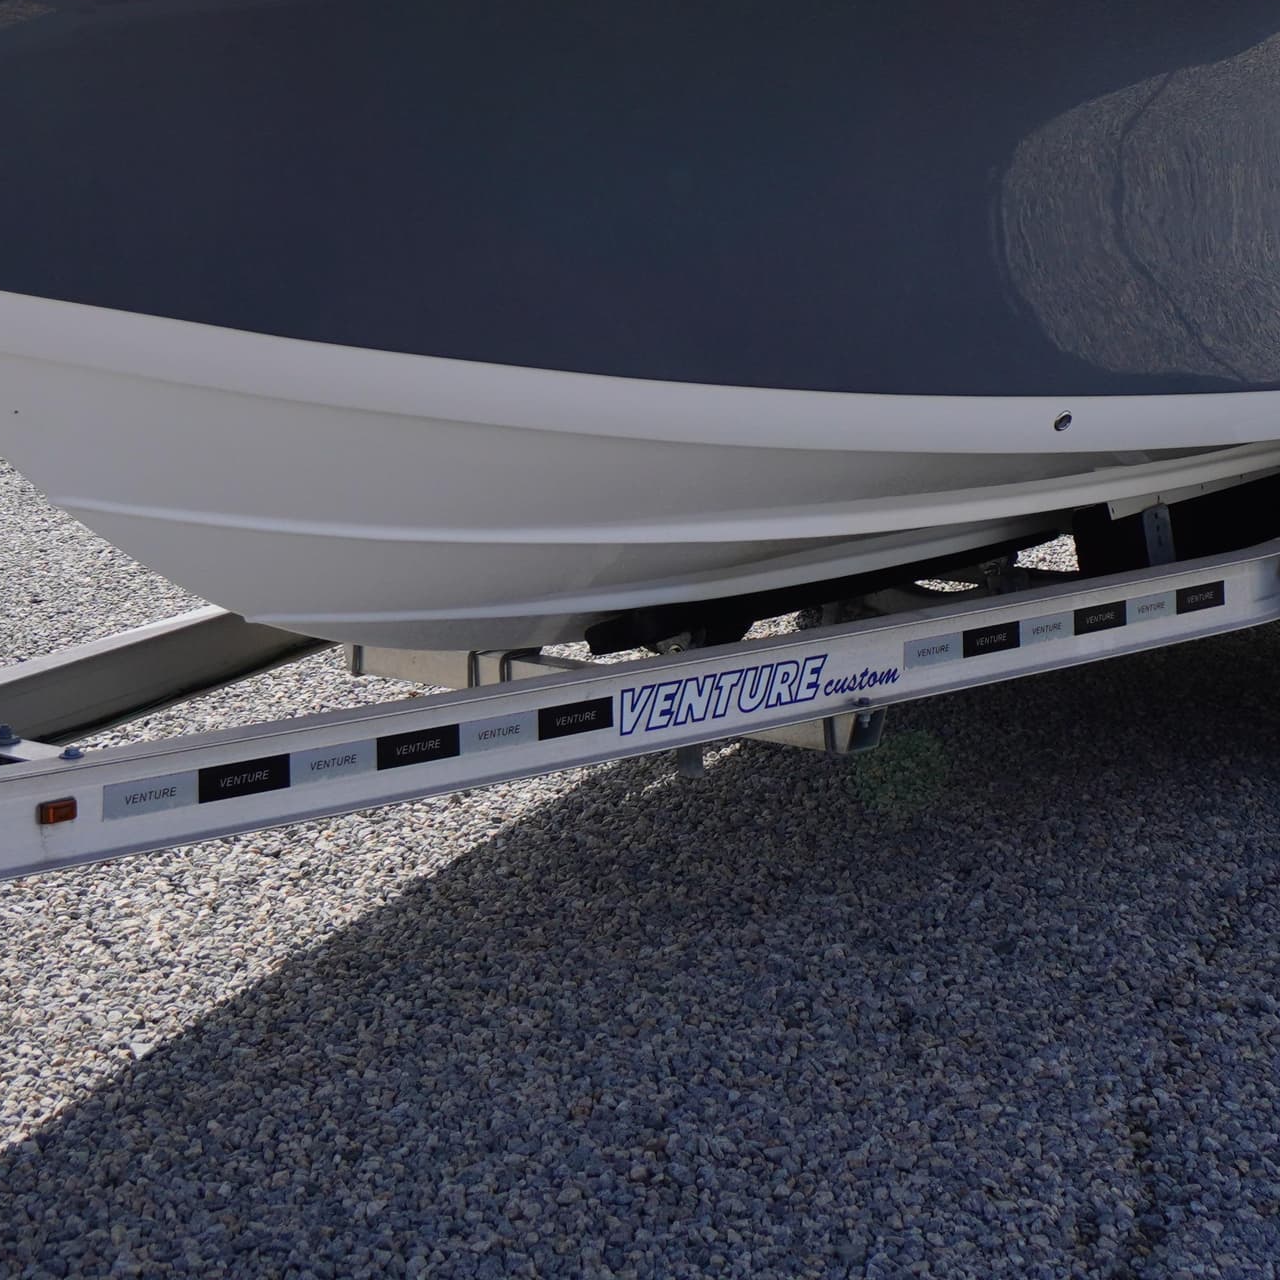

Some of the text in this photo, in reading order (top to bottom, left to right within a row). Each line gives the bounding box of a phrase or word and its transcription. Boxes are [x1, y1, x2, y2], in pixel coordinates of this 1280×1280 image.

[917, 591, 1214, 657] VENTURE VENTURE VENTURE VENTURE VENTURE VENTURE
[620, 654, 900, 736] VENTURE custom
[125, 710, 597, 805] VENTURE VENTURE VENTURE VENTURE VENTURE VENTURE
